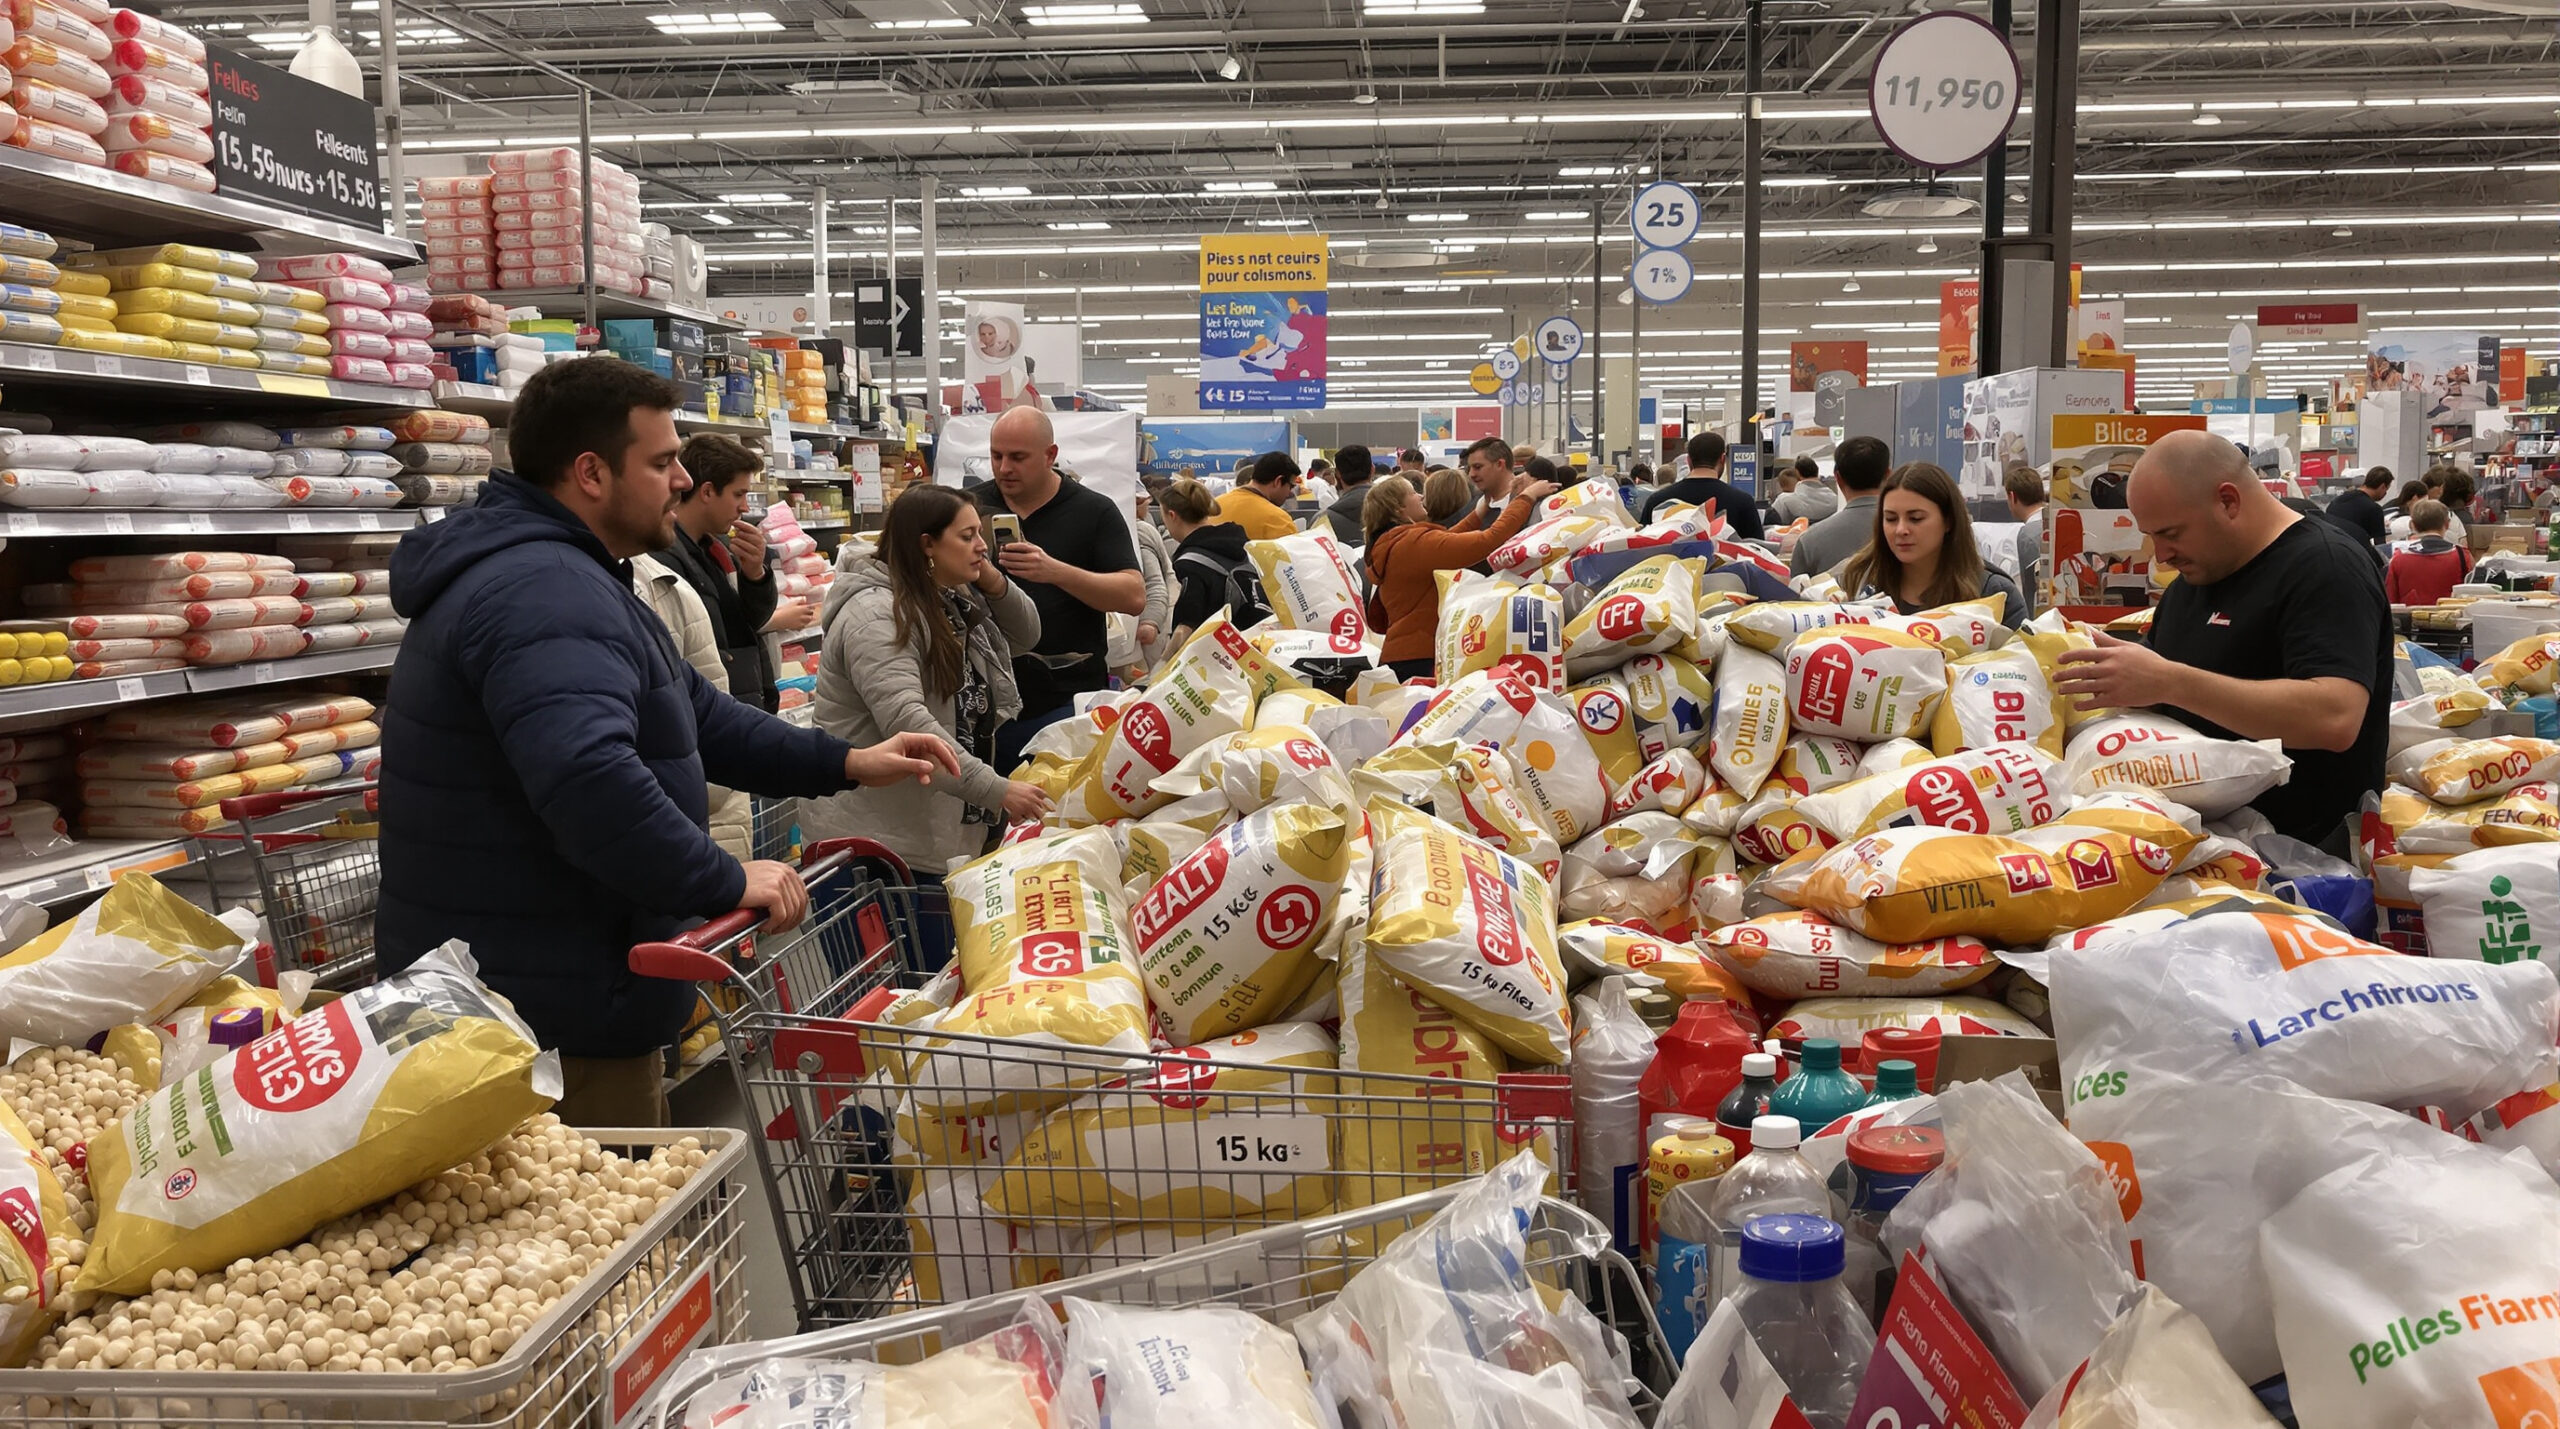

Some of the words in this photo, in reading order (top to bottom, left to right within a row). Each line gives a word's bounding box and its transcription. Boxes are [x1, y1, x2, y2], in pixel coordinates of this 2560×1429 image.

[214, 62, 260, 101] Felles
[1885, 75, 2004, 113] 11,950
[1646, 202, 1684, 227] 25
[1207, 252, 1235, 265] Pies
[1132, 850, 1214, 945] REALT
[1462, 961, 1483, 980] 15
[1216, 1135, 1248, 1162] 15
